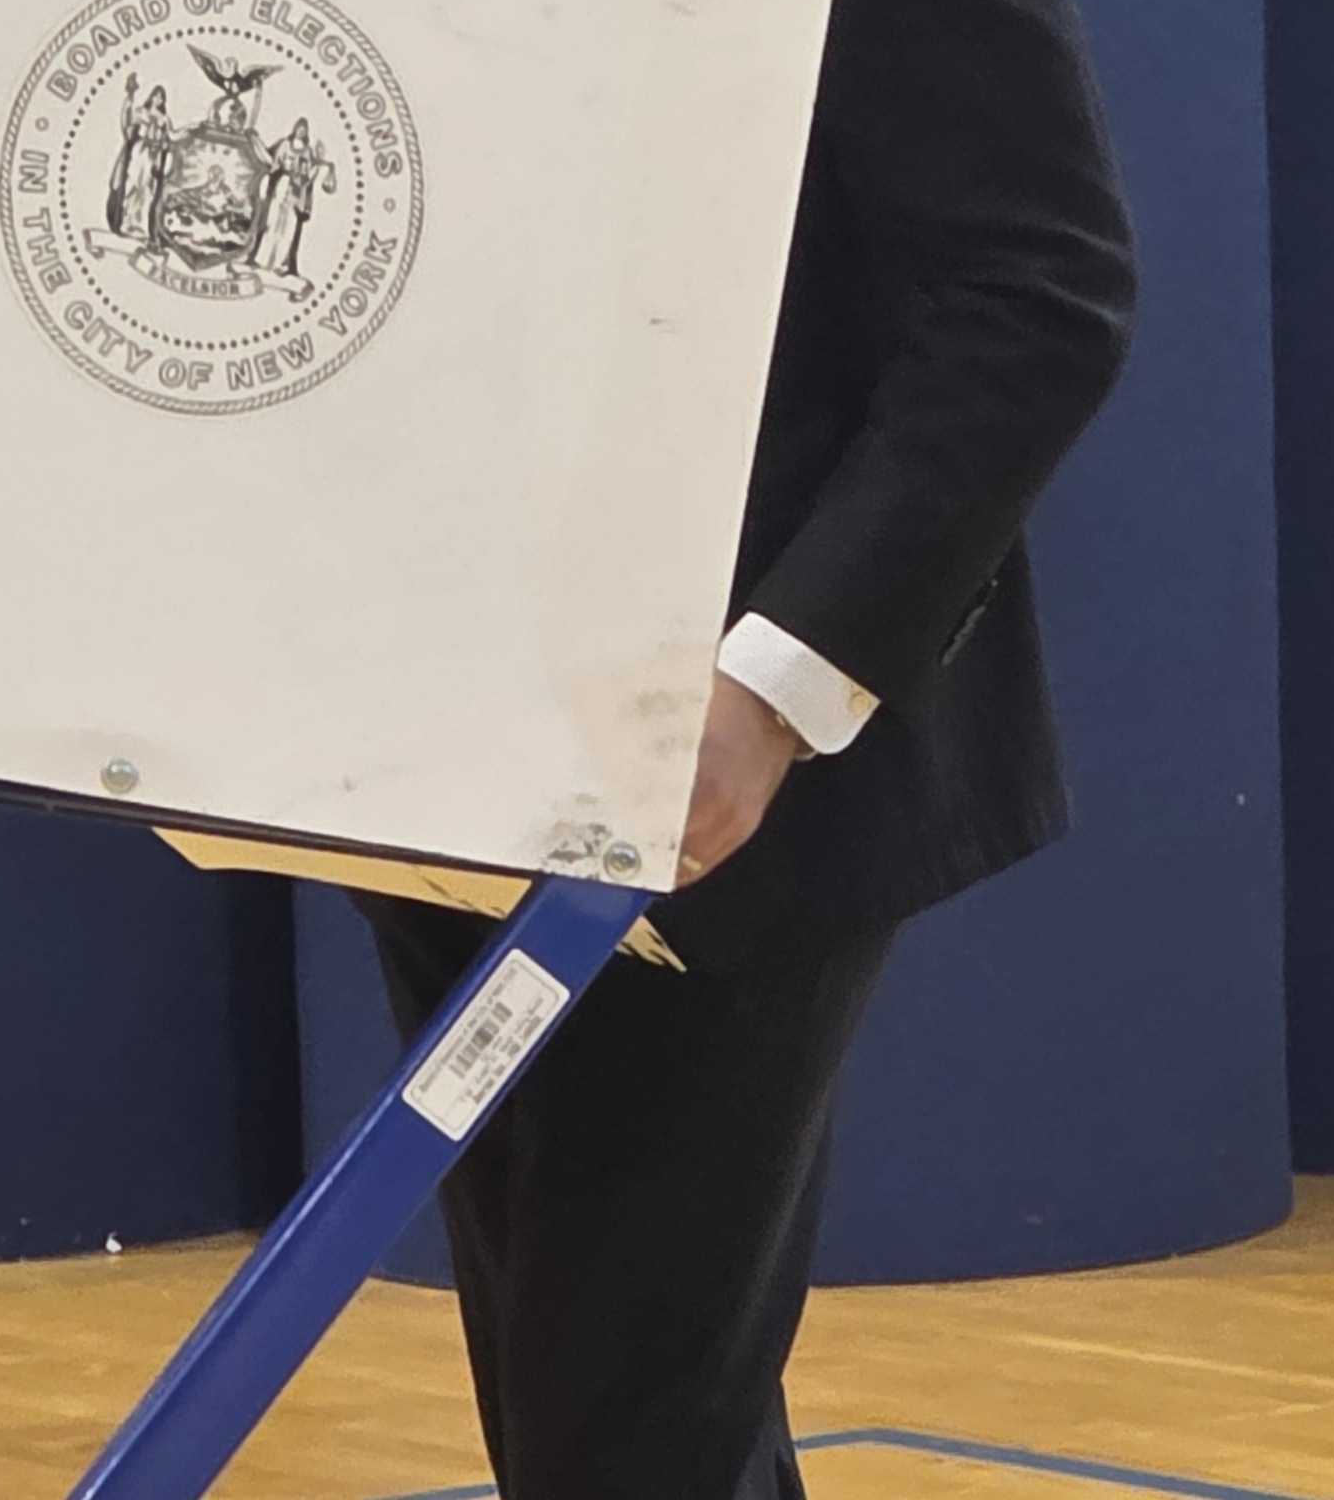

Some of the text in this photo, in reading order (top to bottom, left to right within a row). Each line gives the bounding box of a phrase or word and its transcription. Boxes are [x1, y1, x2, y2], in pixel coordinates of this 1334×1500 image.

[19, 149, 399, 390] IN THE CITY OF NEW YORK
